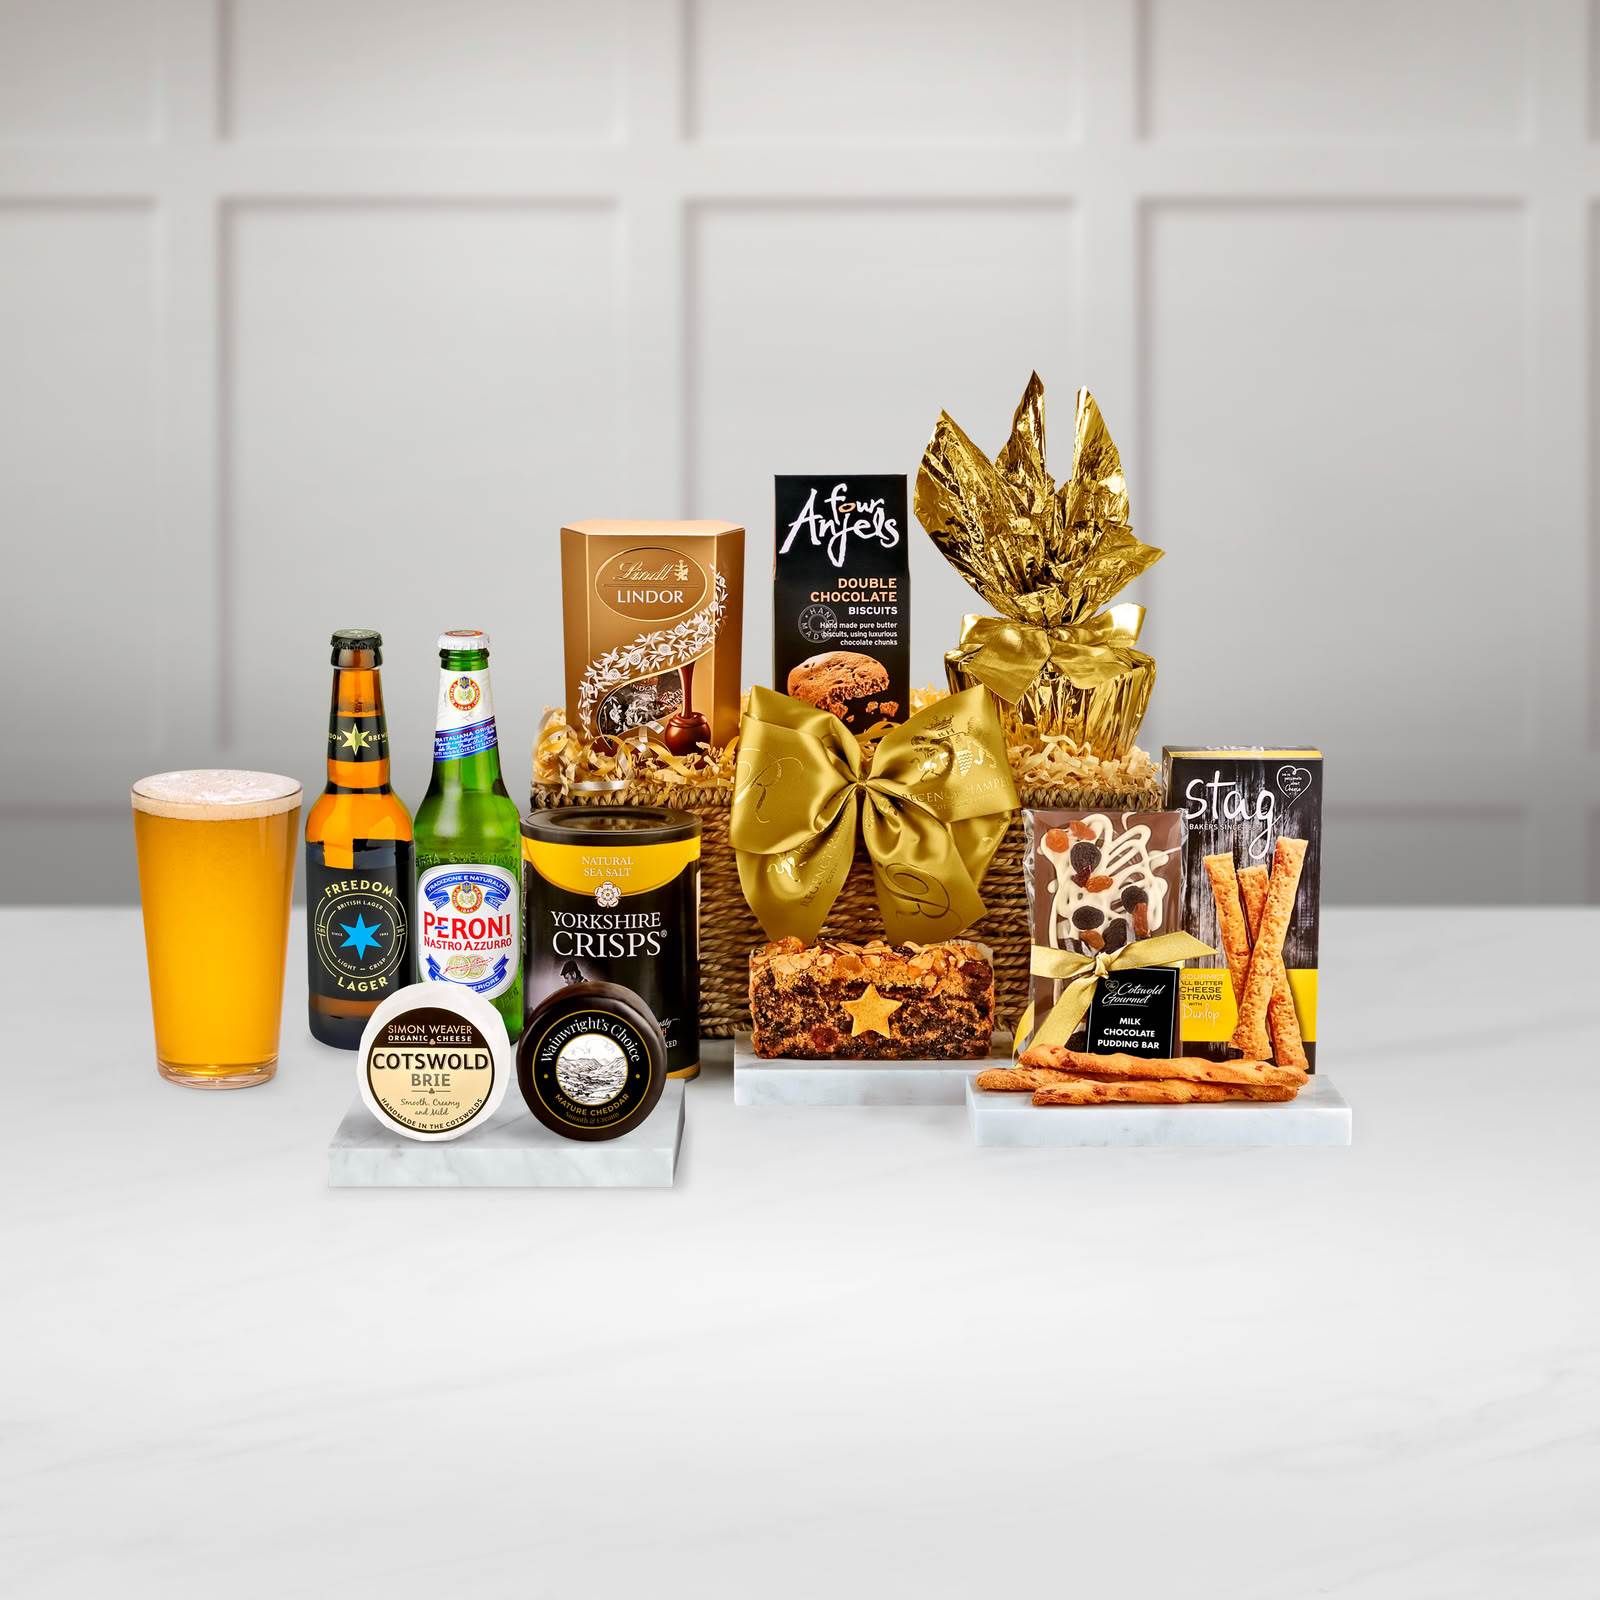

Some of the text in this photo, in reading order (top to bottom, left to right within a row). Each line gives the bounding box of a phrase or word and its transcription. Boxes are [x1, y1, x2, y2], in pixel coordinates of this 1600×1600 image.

[824, 483, 885, 525] four
[613, 561, 674, 581] Lindt
[838, 578, 897, 588] DOUBLE
[617, 590, 684, 603] LINDOR
[810, 591, 897, 602] CHOCOLATE
[848, 606, 898, 615] BISCUITS
[860, 623, 875, 632] pure
[850, 631, 868, 639] using
[581, 856, 634, 865] NATURAL
[583, 867, 632, 877] SEA SALT
[325, 879, 394, 898] FREEDOM
[337, 900, 383, 910] BRITISH LAGER
[423, 911, 511, 940] PERONI
[550, 911, 662, 930] YORKSHIRE
[423, 936, 512, 951] NASTRO AZZURRO
[337, 957, 386, 971] LIGHT CRISP
[337, 976, 389, 992] LAGER
[1117, 982, 1166, 996] Cotswold
[1101, 992, 1152, 1006] Gourmet
[1180, 993, 1222, 1001] STRAWS
[1183, 1003, 1220, 1026] Dunlop
[1119, 1017, 1141, 1026] MILK
[387, 1024, 473, 1035] SIMON WEAVER
[1103, 1028, 1156, 1038] CHOCOLATE
[541, 1017, 640, 1063] Wainwright's Choice
[1097, 1039, 1160, 1050] PUDDING BAR
[372, 1053, 489, 1070] COTSWOLD
[411, 1073, 451, 1087] BRIE
[432, 1098, 461, 1109] Creamy
[555, 1093, 630, 1117] MATURE CHEDDAR
[381, 1097, 416, 1127] HANDMADE
[445, 1097, 483, 1128] COTSWOLDS
[414, 1107, 449, 1116] and Mild
